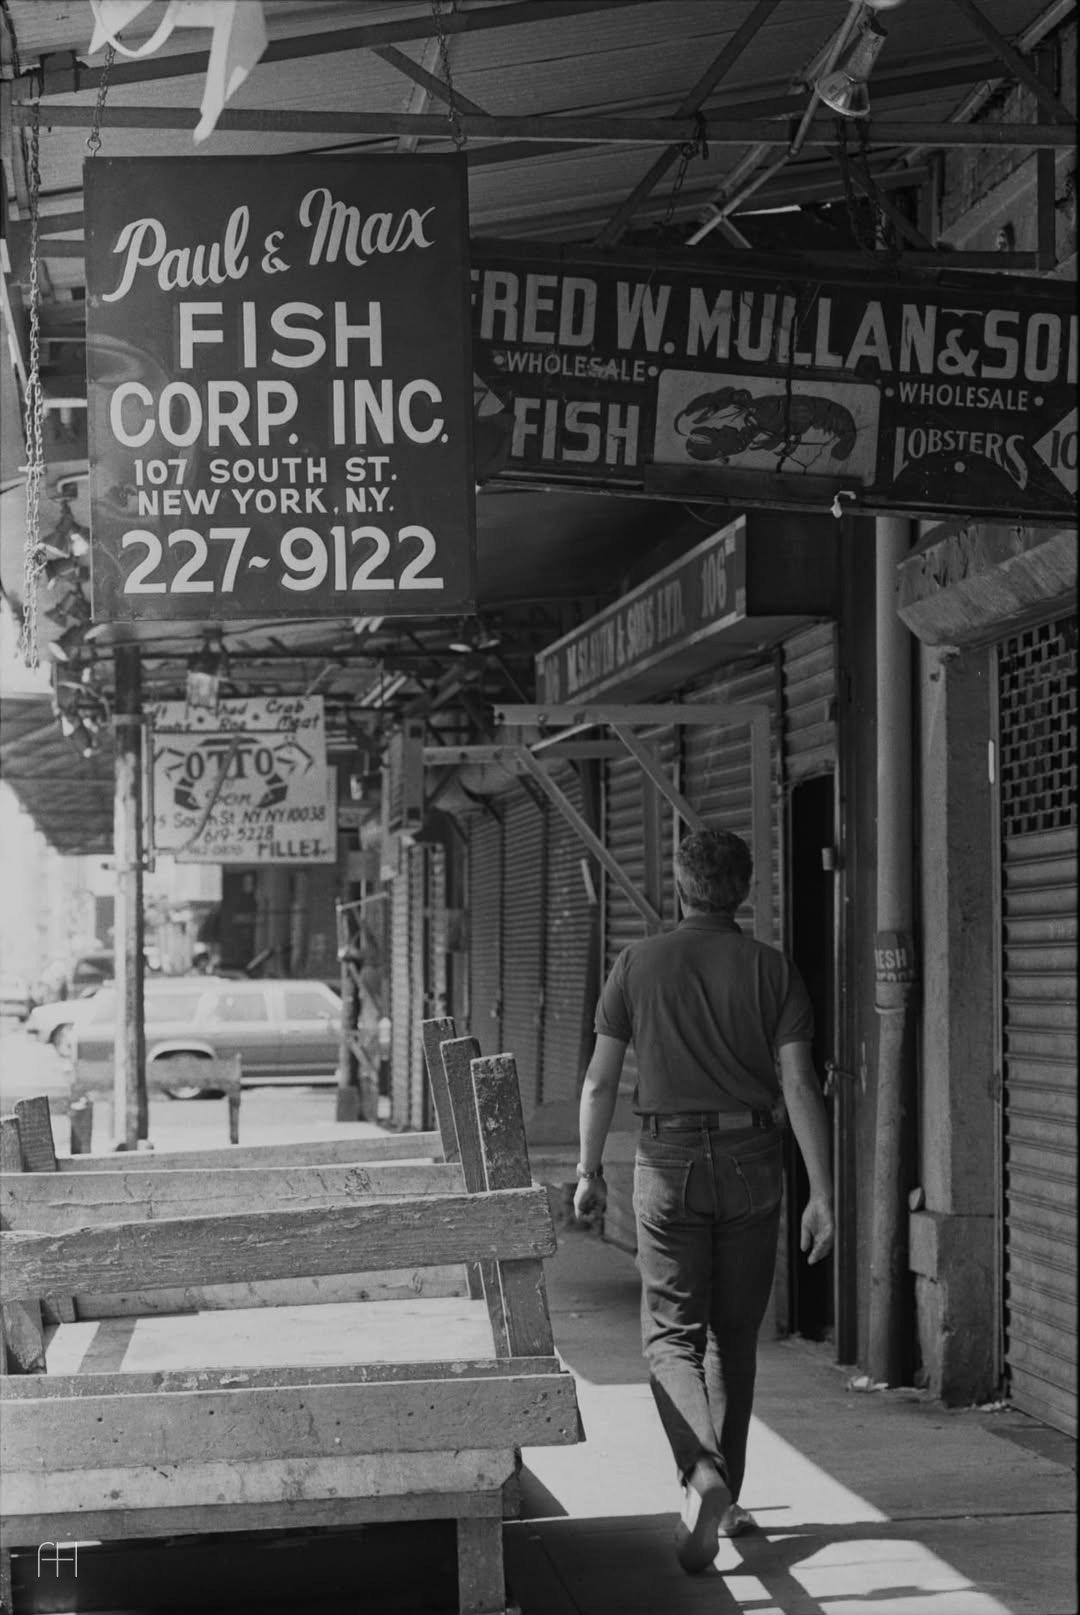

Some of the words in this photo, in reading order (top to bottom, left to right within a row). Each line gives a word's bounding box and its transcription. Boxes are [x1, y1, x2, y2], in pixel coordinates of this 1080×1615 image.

[102, 205, 249, 302] Paul
[261, 231, 290, 274] &
[300, 188, 436, 266] Max
[179, 301, 383, 369] FISH
[687, 288, 938, 373] MULLAN
[506, 351, 646, 382] WHOLESALE
[898, 381, 1029, 413] WHOLESALE
[109, 380, 299, 447] CORP.
[332, 379, 449, 444] INC.
[510, 396, 639, 467] FISH
[134, 458, 188, 486] 107
[209, 457, 328, 484] SOUTH
[345, 455, 398, 482] ST.
[893, 425, 1028, 492] LOBSTERS
[137, 489, 220, 515] NEW
[346, 487, 395, 513] N.Y.
[186, 748, 273, 780] OTTO
